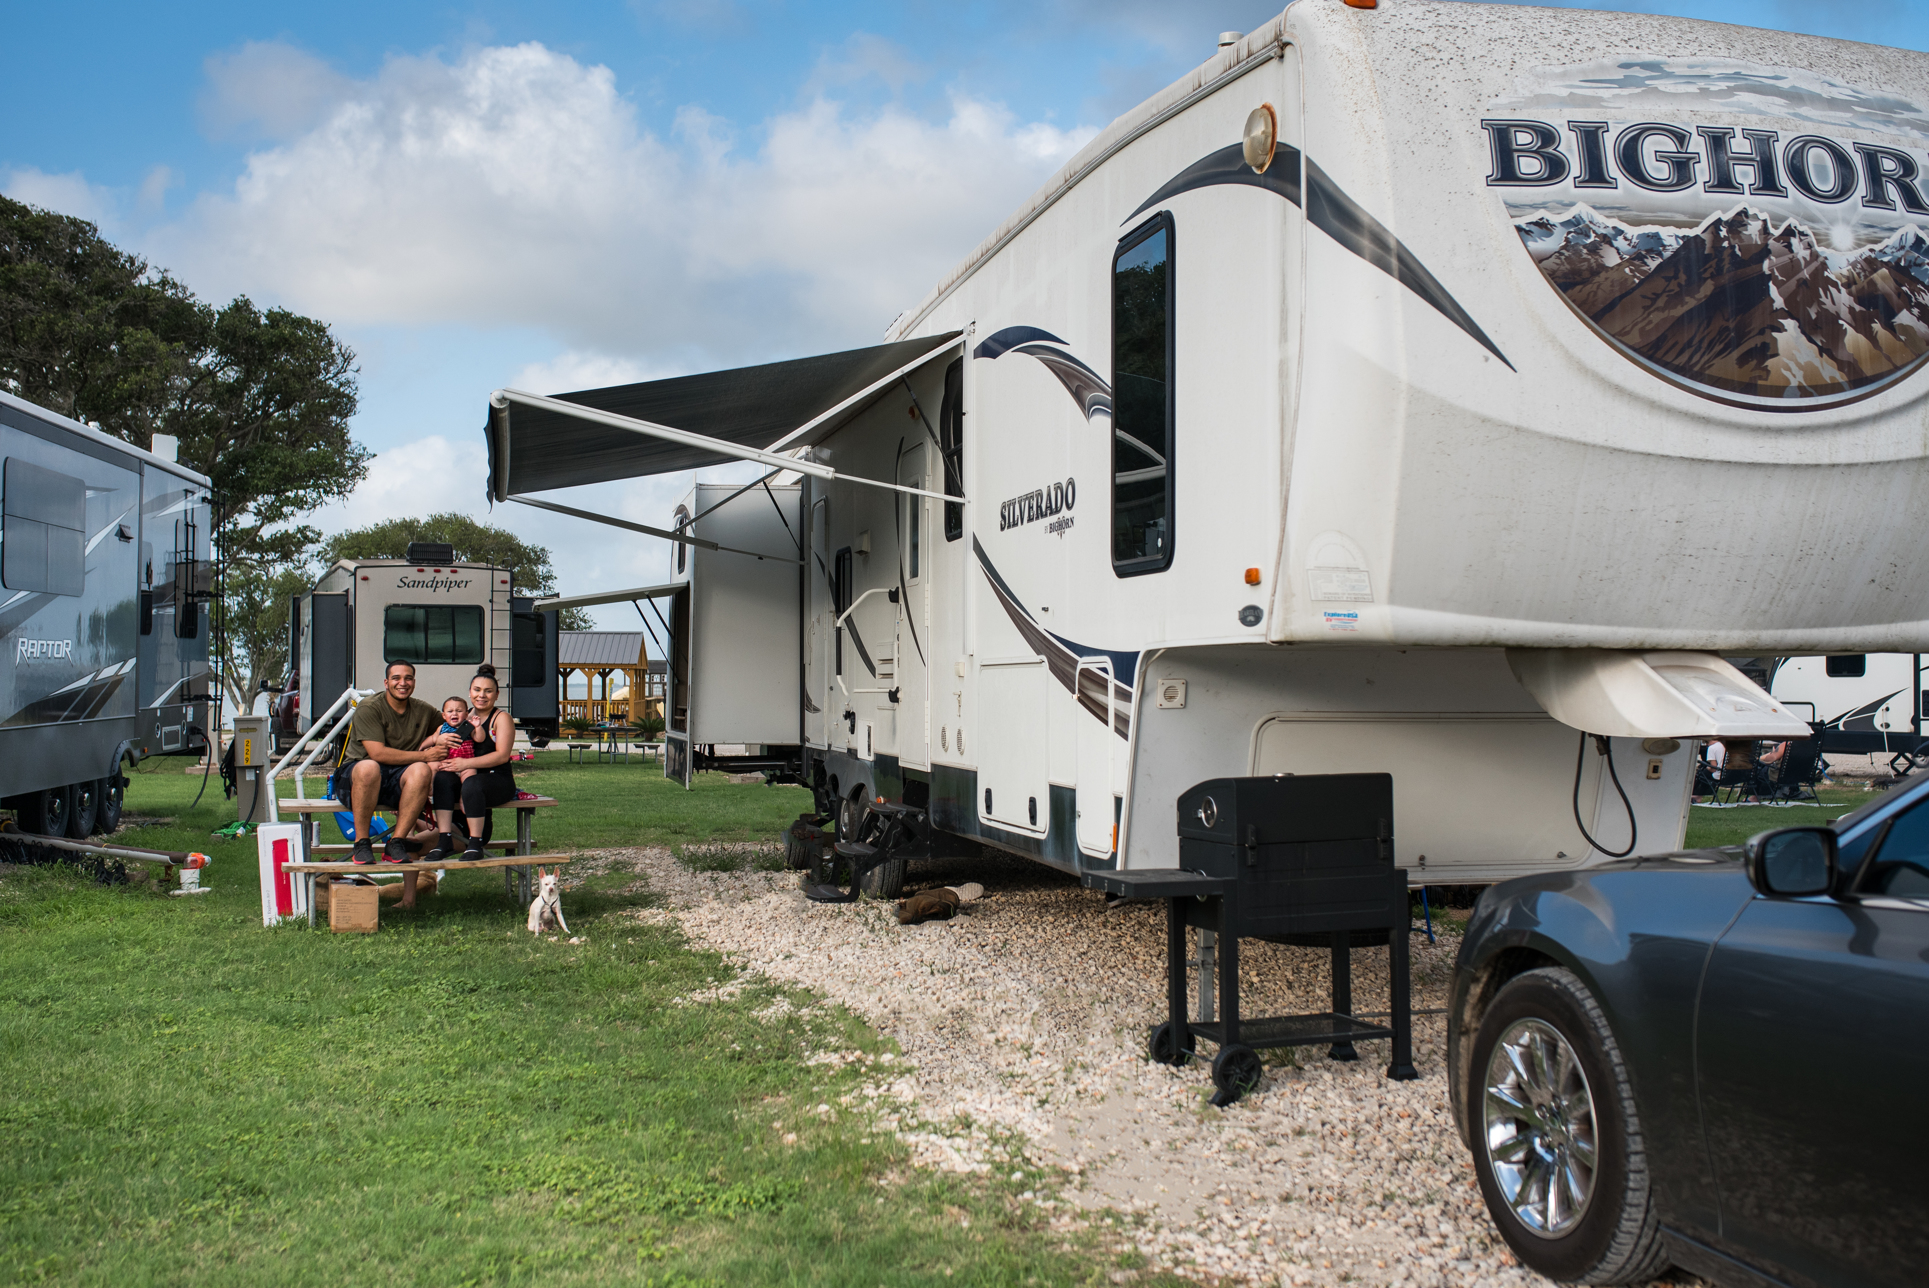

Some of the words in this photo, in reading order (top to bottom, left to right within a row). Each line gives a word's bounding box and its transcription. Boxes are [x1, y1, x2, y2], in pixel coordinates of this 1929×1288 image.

[1481, 119, 1929, 215] BIGHOR
[1000, 477, 1076, 532] SILVERADO
[1049, 516, 1074, 534] BIGHORN
[397, 576, 472, 592] Sandpiper
[15, 637, 74, 669] RAPTOR
